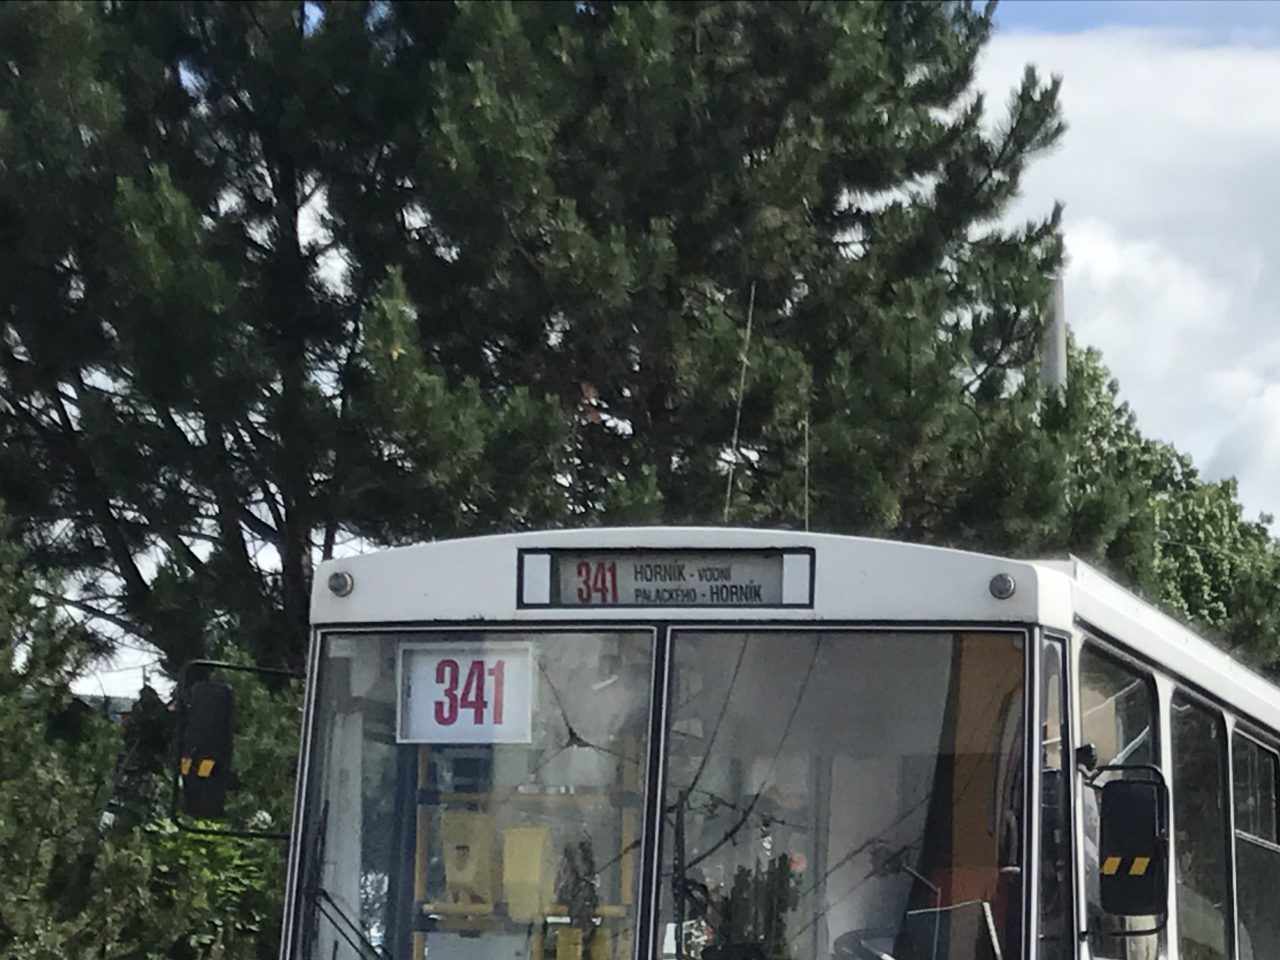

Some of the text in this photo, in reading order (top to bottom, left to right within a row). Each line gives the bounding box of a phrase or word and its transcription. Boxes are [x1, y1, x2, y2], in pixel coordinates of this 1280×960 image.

[576, 561, 619, 604] 341
[709, 579, 762, 602] HORNÍK
[434, 659, 505, 726] 341
